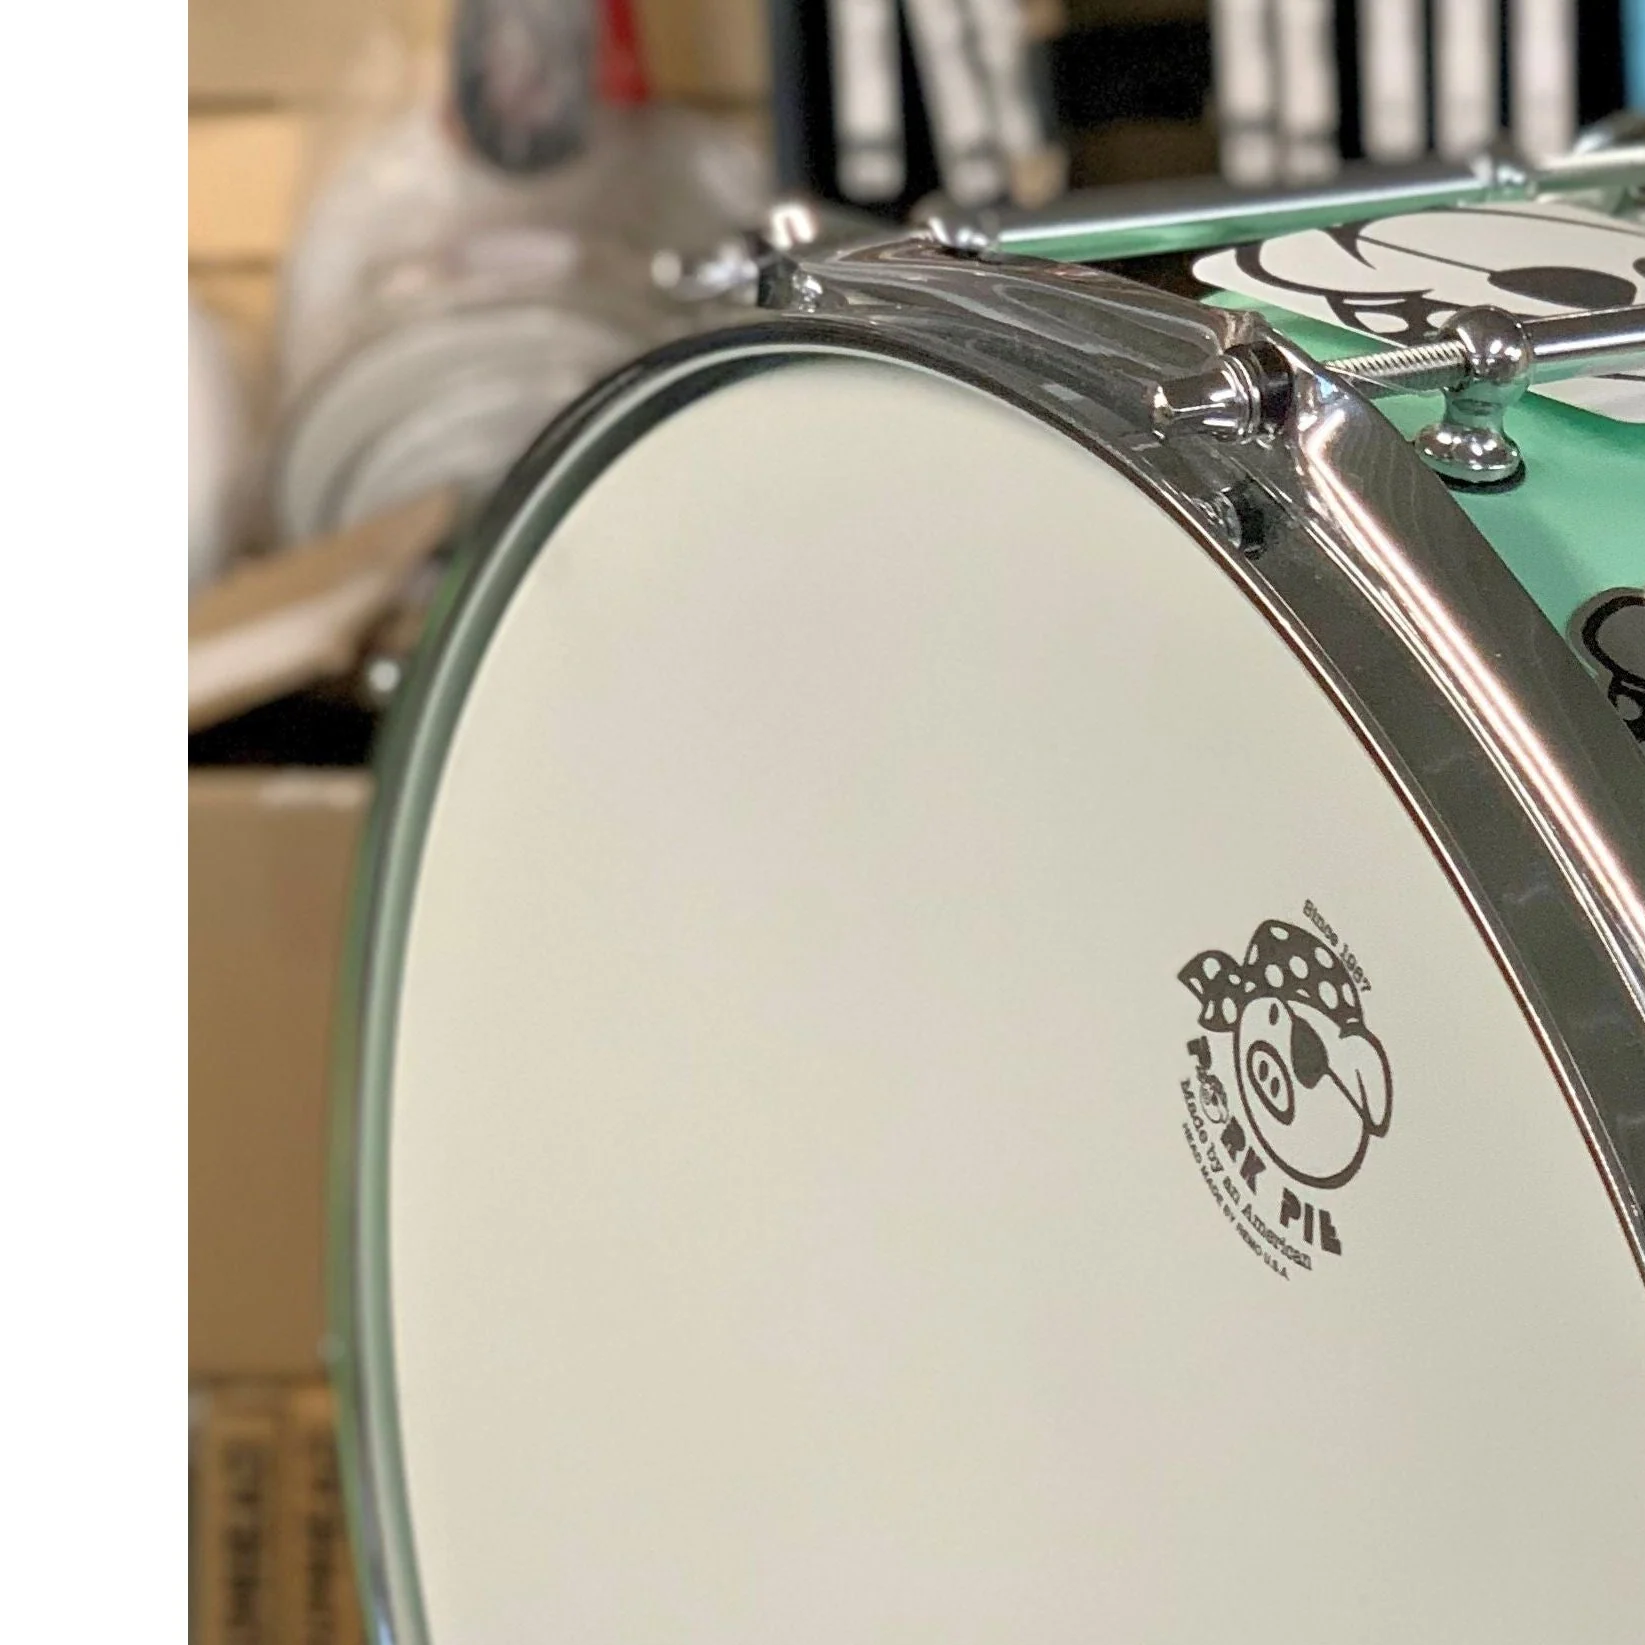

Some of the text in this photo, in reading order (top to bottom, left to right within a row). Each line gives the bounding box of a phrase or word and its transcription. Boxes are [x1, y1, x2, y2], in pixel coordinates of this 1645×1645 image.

[1302, 898, 1371, 992] Since 1987
[1180, 1076, 1313, 1271] Made by an American
[1279, 1187, 1342, 1256] PIE
